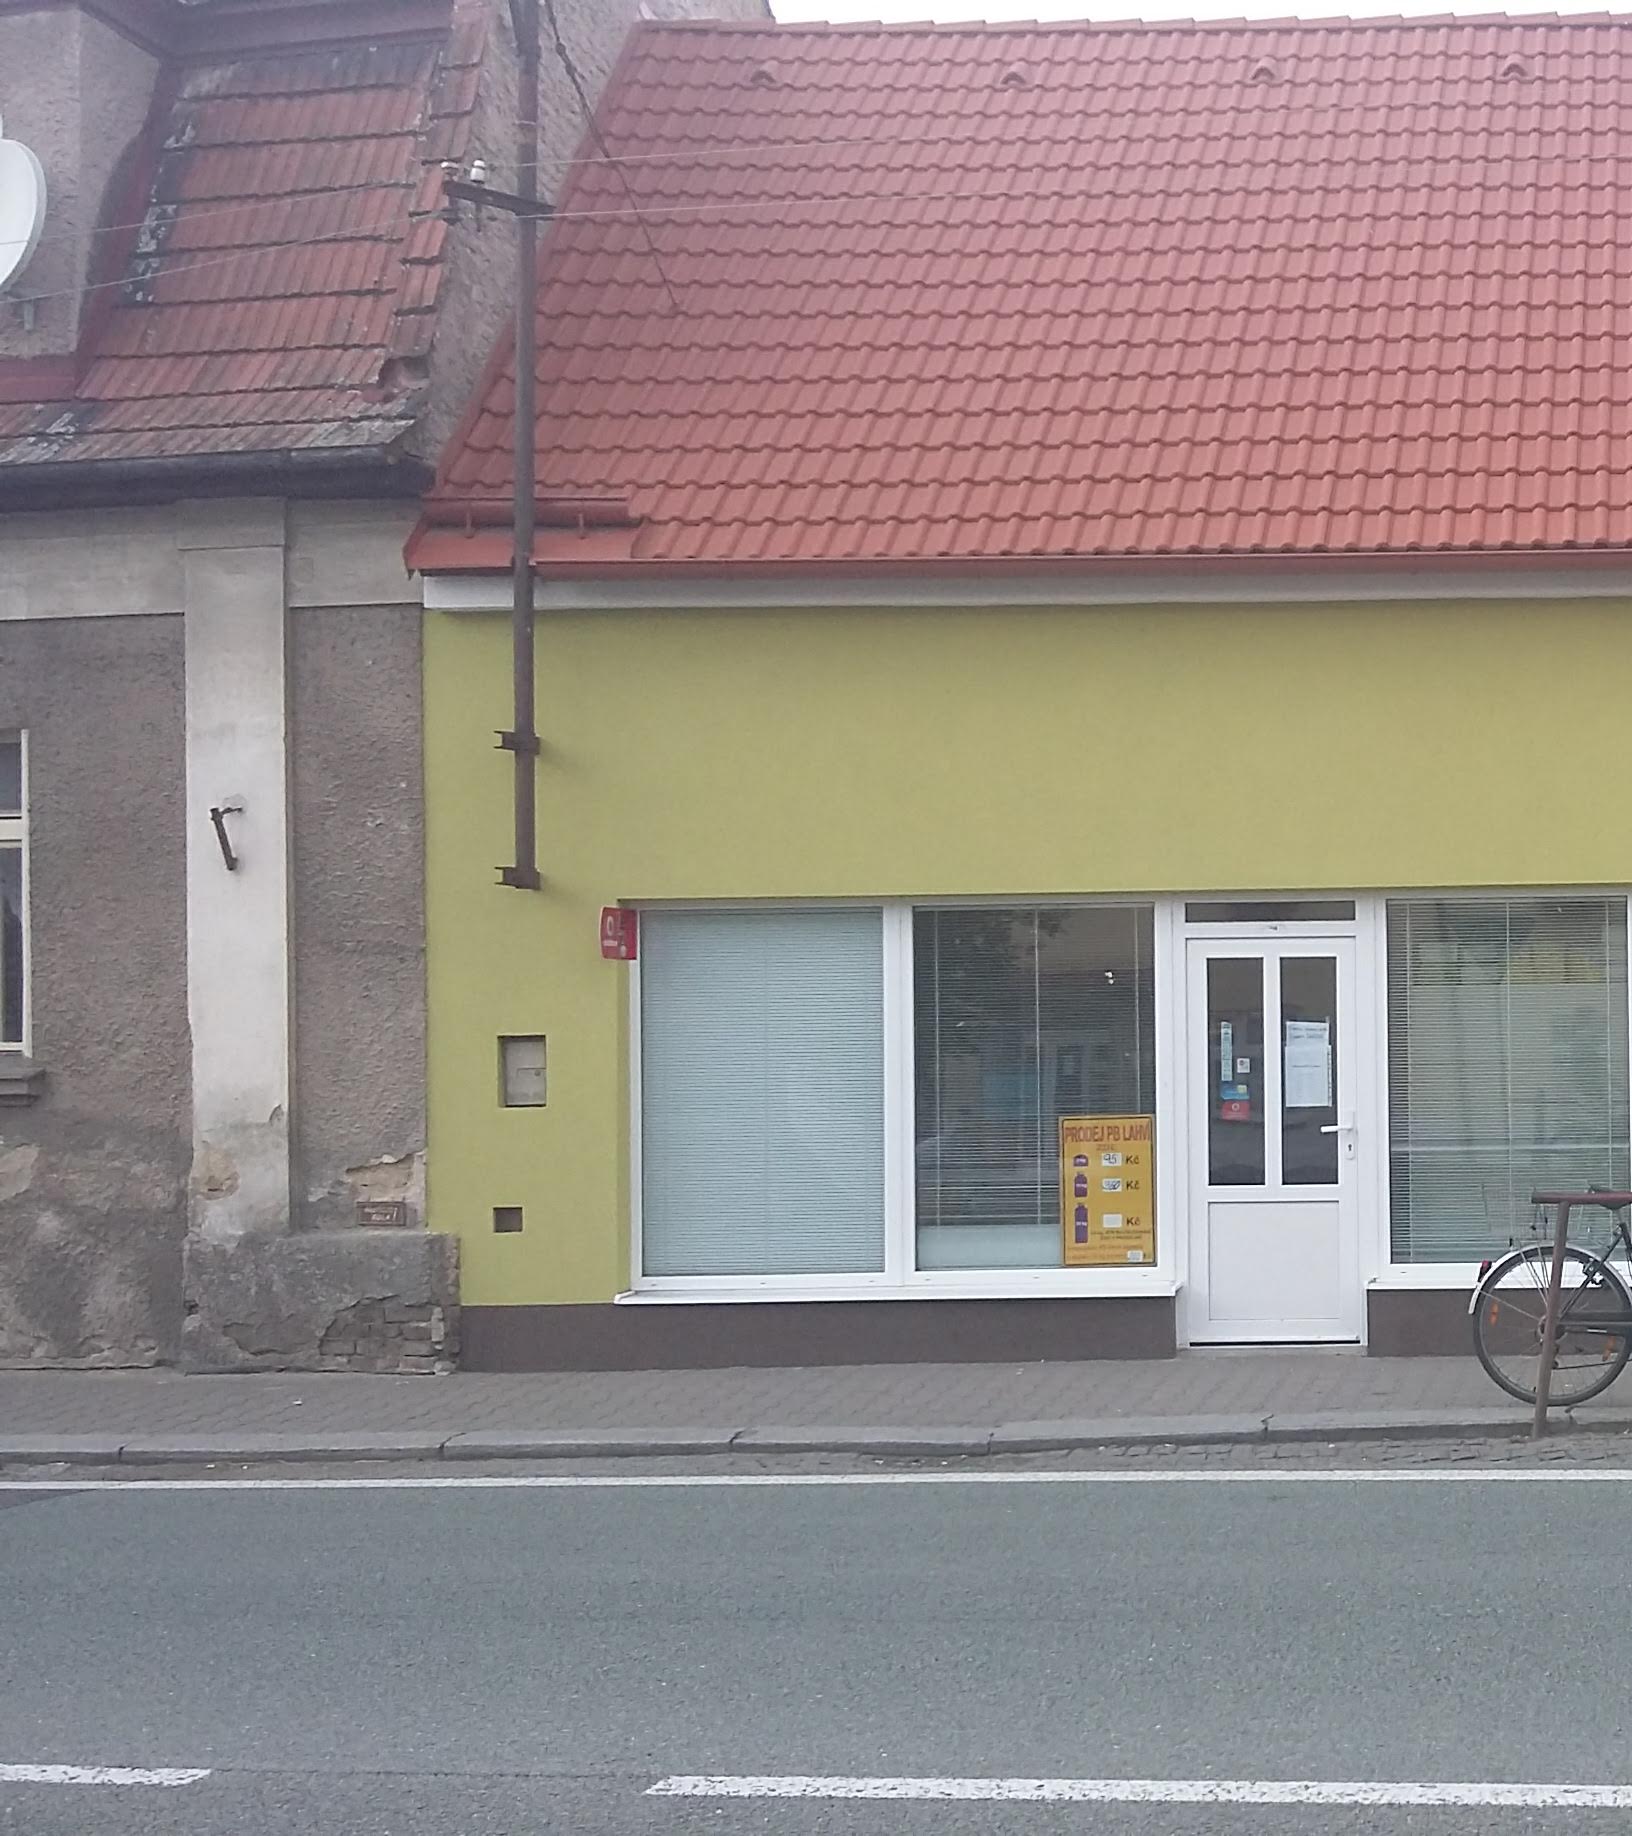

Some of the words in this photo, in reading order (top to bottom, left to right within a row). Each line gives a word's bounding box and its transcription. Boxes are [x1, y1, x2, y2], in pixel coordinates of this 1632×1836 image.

[1064, 1125, 1104, 1143] PRODEJ
[1107, 1125, 1120, 1142] PB
[1126, 1180, 1140, 1190] Kč
[1126, 1216, 1140, 1226] Kč
